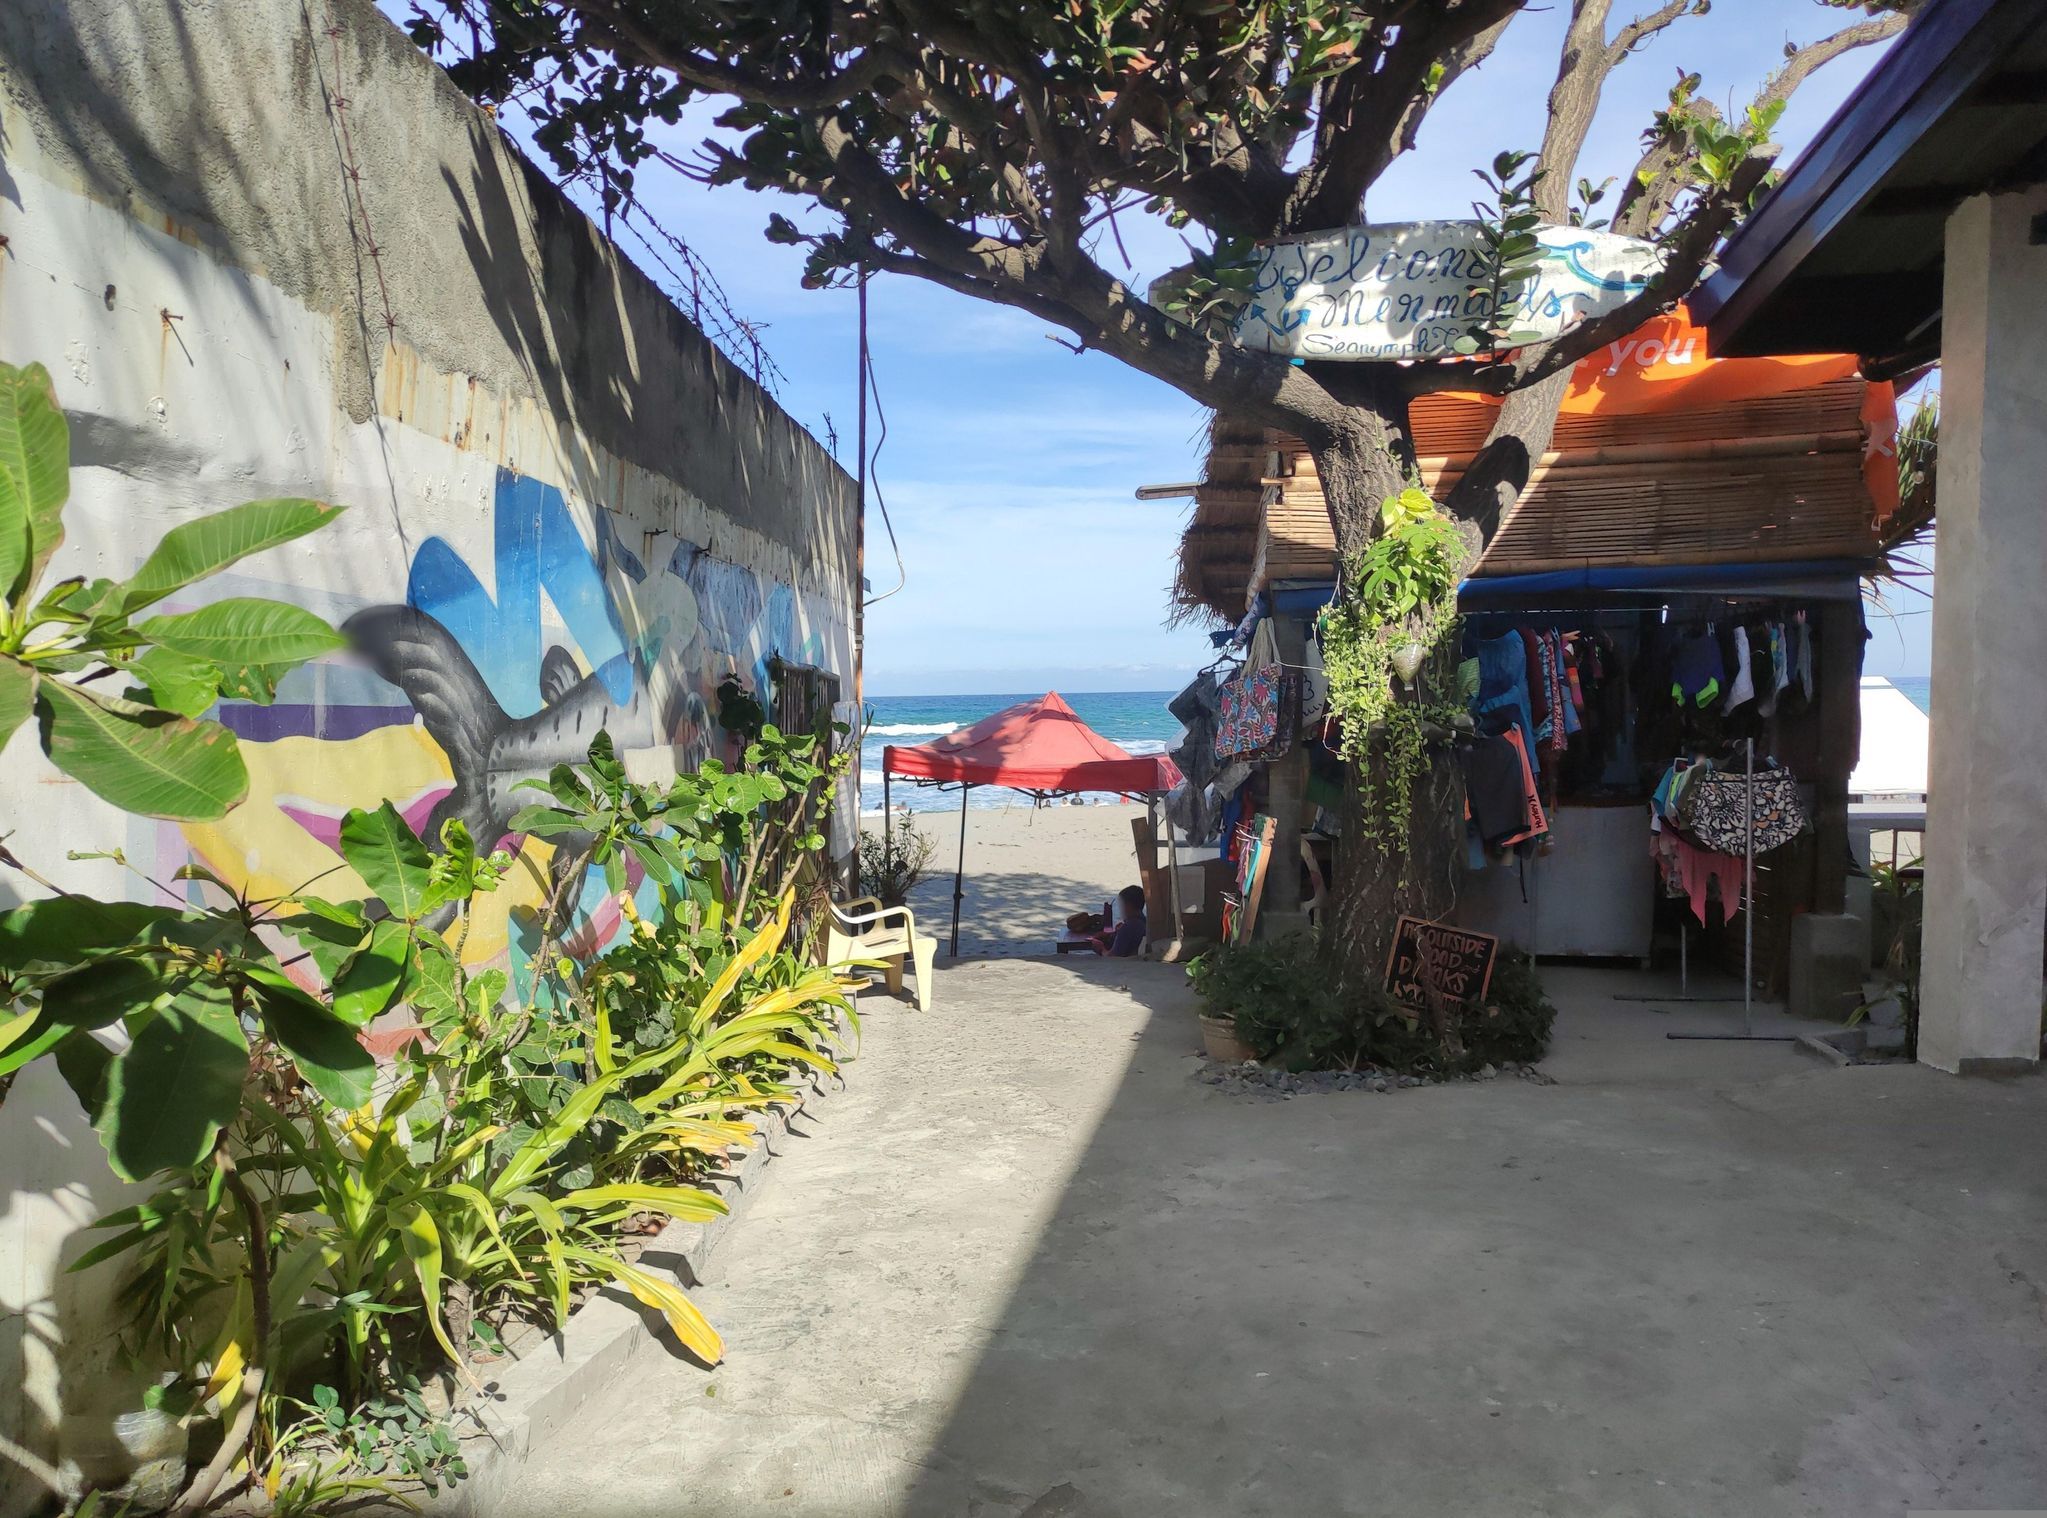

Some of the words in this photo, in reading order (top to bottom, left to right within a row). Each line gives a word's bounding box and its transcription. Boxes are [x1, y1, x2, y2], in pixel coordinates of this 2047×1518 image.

[1253, 234, 1496, 293] Welcome
[1606, 336, 1697, 378] you
[1429, 948, 1463, 969] OOD
